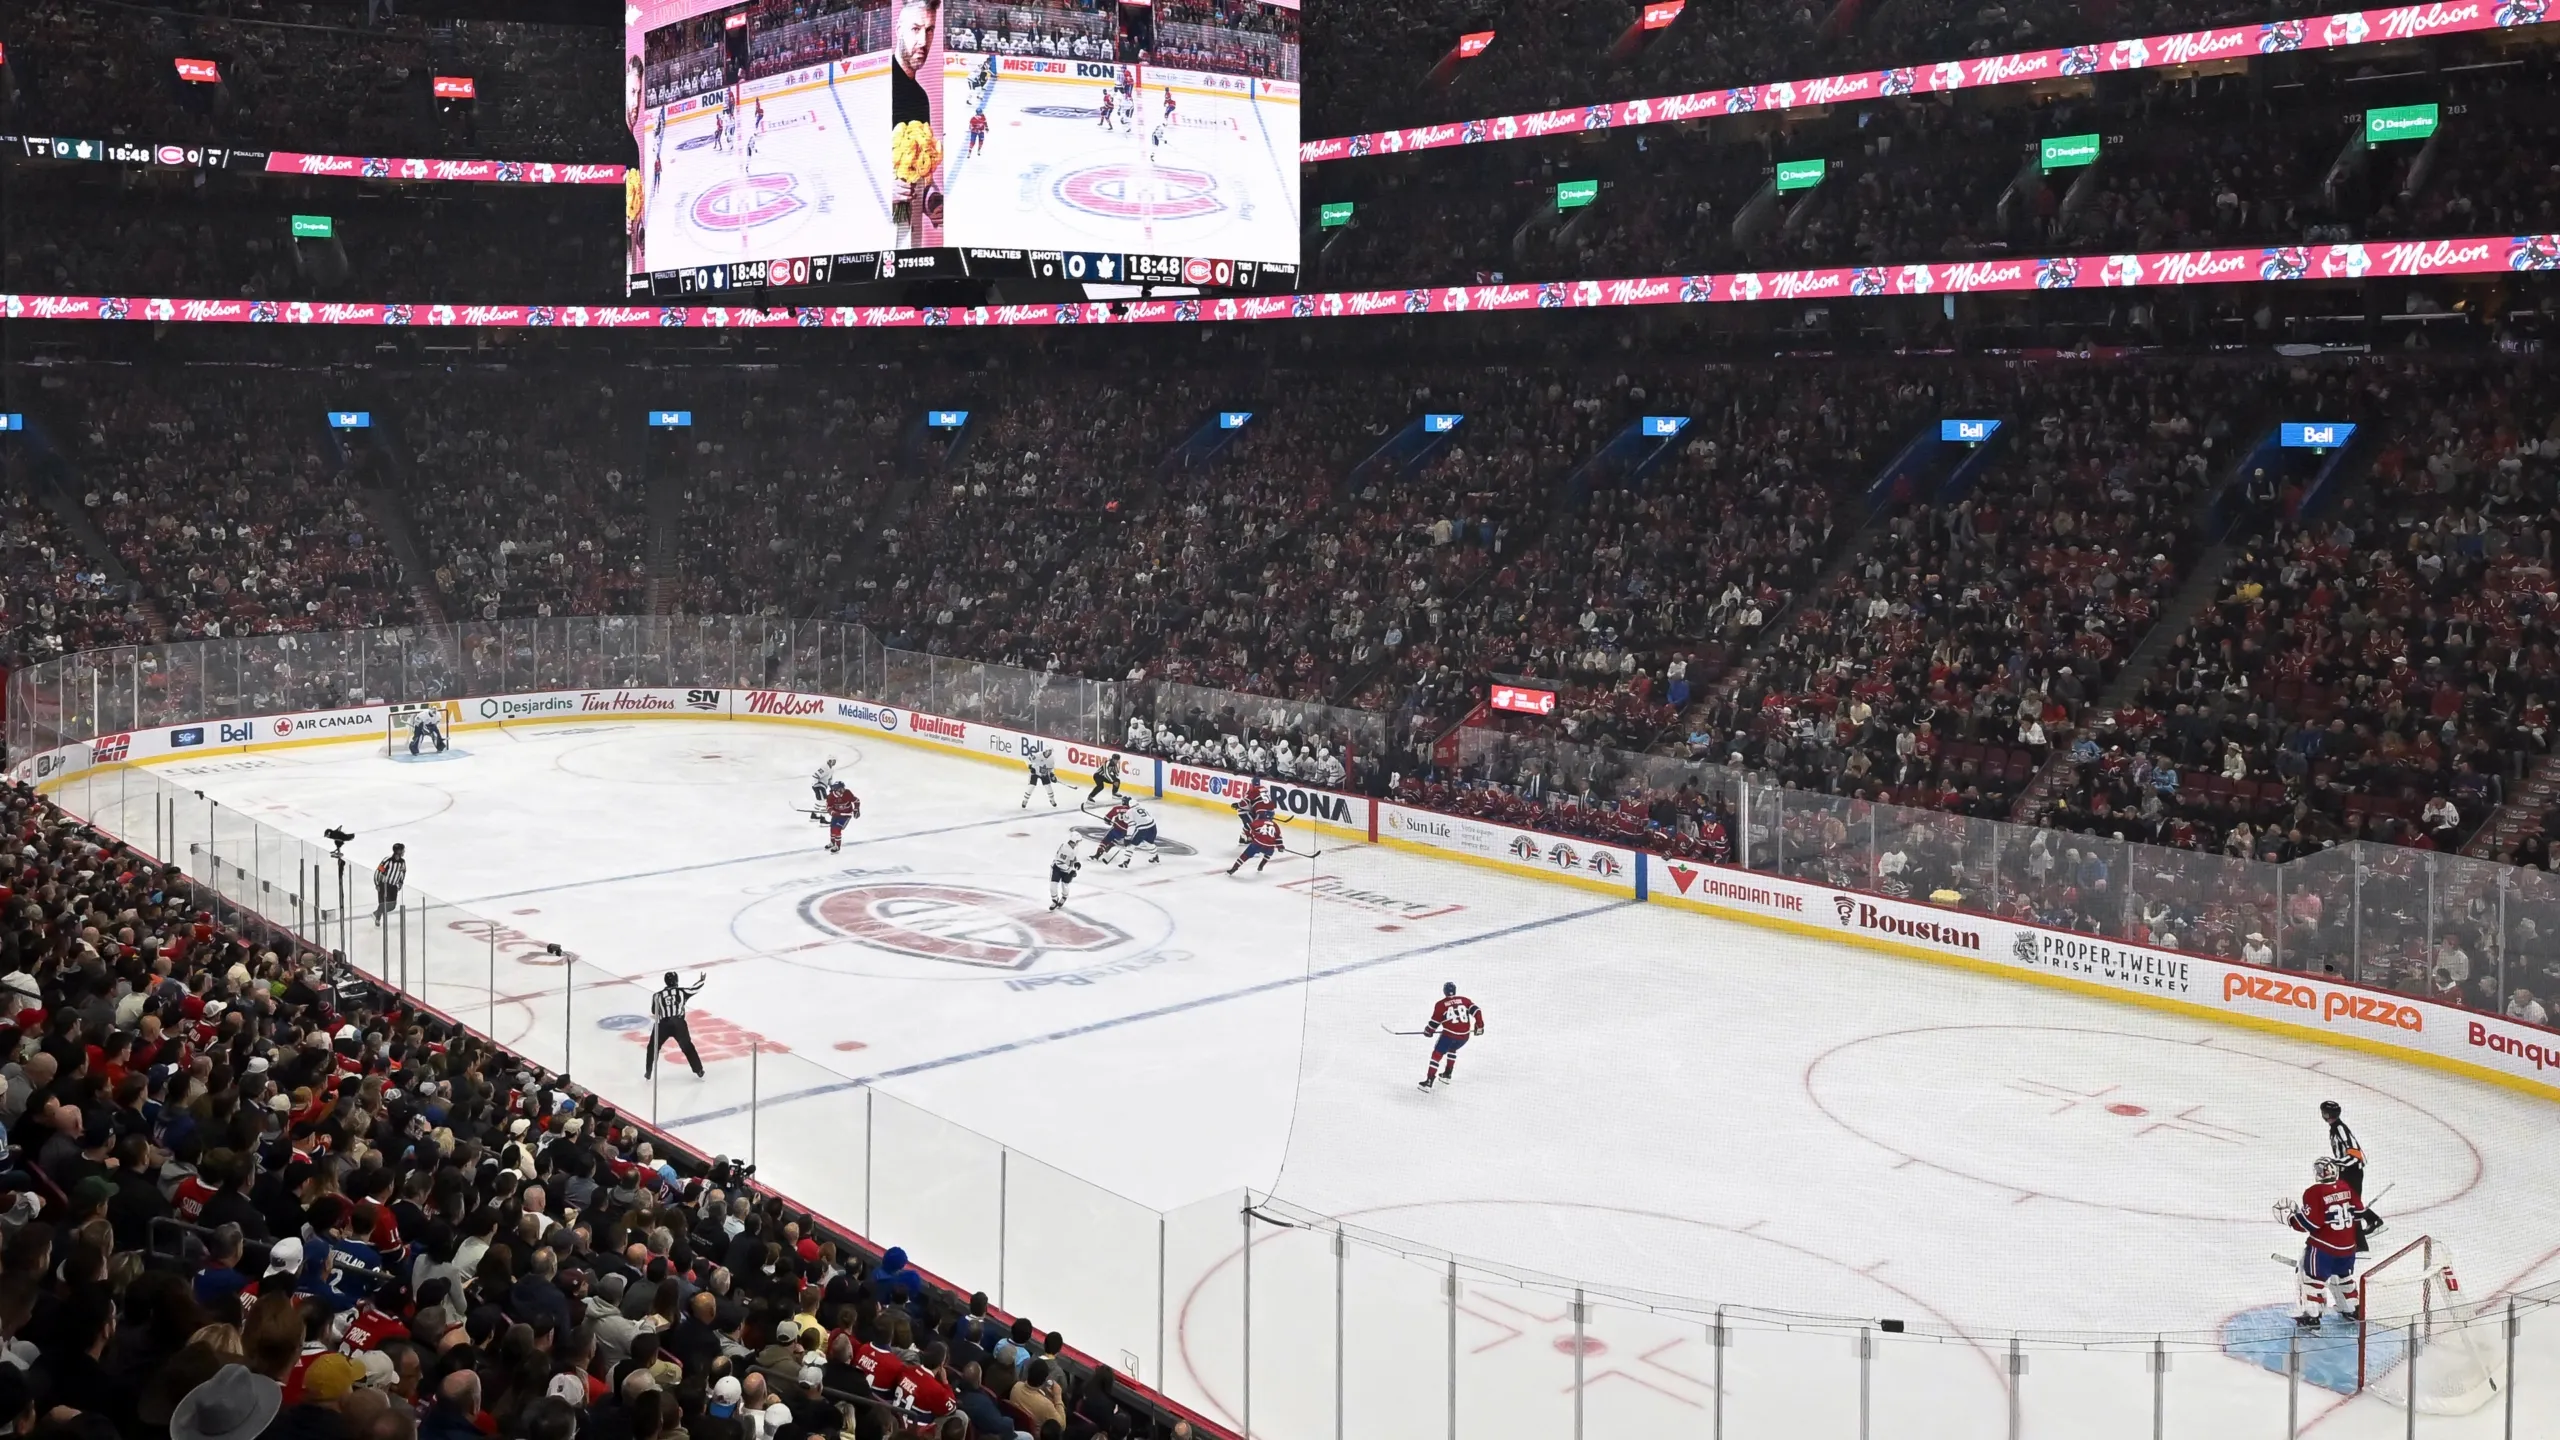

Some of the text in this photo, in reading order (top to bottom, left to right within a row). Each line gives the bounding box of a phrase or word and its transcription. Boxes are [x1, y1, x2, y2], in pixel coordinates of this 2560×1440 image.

[2380, 3, 2478, 38] Molson
[2157, 30, 2243, 62] Molson
[1077, 63, 1115, 79] RON
[1971, 55, 2048, 84] Molson
[701, 91, 724, 108] RON
[1801, 76, 1868, 104] Molson
[1657, 94, 1717, 121] Molson
[1522, 112, 1576, 136] Molson
[2386, 117, 2433, 129] Desjardins
[1407, 126, 1455, 149] Molson
[57, 141, 70, 155] 0
[108, 147, 150, 162] 18:48
[1300, 141, 1341, 162] Molson
[2057, 146, 2096, 157] Desjardins
[187, 153, 199, 163] 0
[208, 156, 217, 166] 0
[299, 155, 352, 174] Molson
[434, 160, 488, 179] Molson
[561, 165, 614, 183] Molson
[813, 257, 827, 267] TIRS
[838, 253, 875, 264] PÉNALITÉS
[971, 248, 1022, 261] PENALTIES
[1032, 250, 1061, 261] SHOTS
[2381, 240, 2490, 276] Molson
[732, 263, 766, 281] 18:48
[793, 262, 804, 283] 0
[815, 268, 823, 281] 0
[1043, 263, 1053, 277] 0
[1069, 254, 1086, 278] 0
[1129, 255, 1180, 275] 18:48
[1215, 261, 1230, 285] 0
[1237, 261, 1253, 271] TIRS
[1263, 261, 1295, 275] PÉNALITÉS
[2152, 251, 2245, 285] Molson
[686, 280, 692, 291] 3
[698, 272, 708, 290] 0
[1240, 272, 1248, 285] 0
[1769, 270, 1839, 299] Molson
[1941, 261, 2022, 292] Molson
[1474, 285, 1529, 310] Molson
[1608, 278, 1669, 305] Molson
[30, 296, 89, 318] Molson
[181, 301, 241, 321] Molson
[1242, 300, 1285, 319] Molson
[1348, 292, 1396, 315] Molson
[319, 303, 374, 324] Molson
[462, 306, 519, 327] Molson
[595, 307, 651, 326] Molson
[863, 306, 915, 326] Molson
[994, 305, 1049, 324] Molson
[340, 414, 358, 425] Bell
[661, 413, 679, 424] Bell
[941, 414, 957, 424] Bell
[1657, 420, 1676, 433] Bell
[1959, 423, 1983, 437] Bell
[2304, 427, 2333, 443] Bell
[502, 697, 573, 715] Desjardins
[580, 690, 675, 712] Tim Hortons
[687, 690, 720, 704] SN
[745, 691, 824, 715] Molson
[296, 713, 373, 731] AIR CANADA
[838, 703, 895, 725] Médailles Esso
[220, 722, 253, 743] Bell
[909, 712, 966, 739] Qualinet
[178, 732, 196, 744] 5G+
[990, 734, 1043, 757] Fibe Bell
[1269, 784, 1353, 825] RONA
[1259, 823, 1275, 838] 40
[1406, 817, 1450, 838] Sun Life
[1703, 878, 1803, 913] CANADIAN TIRE
[1858, 902, 1980, 951] Boustan
[2044, 936, 2188, 981] PROPER TWELVE
[2044, 956, 2189, 993] IRISH WHISKEY
[1446, 1005, 1468, 1023] 48
[2329, 1204, 2354, 1231] 35
[346, 1326, 371, 1346] PRICE
[858, 1355, 878, 1374] PRICE
[900, 1377, 918, 1395] PRICE
